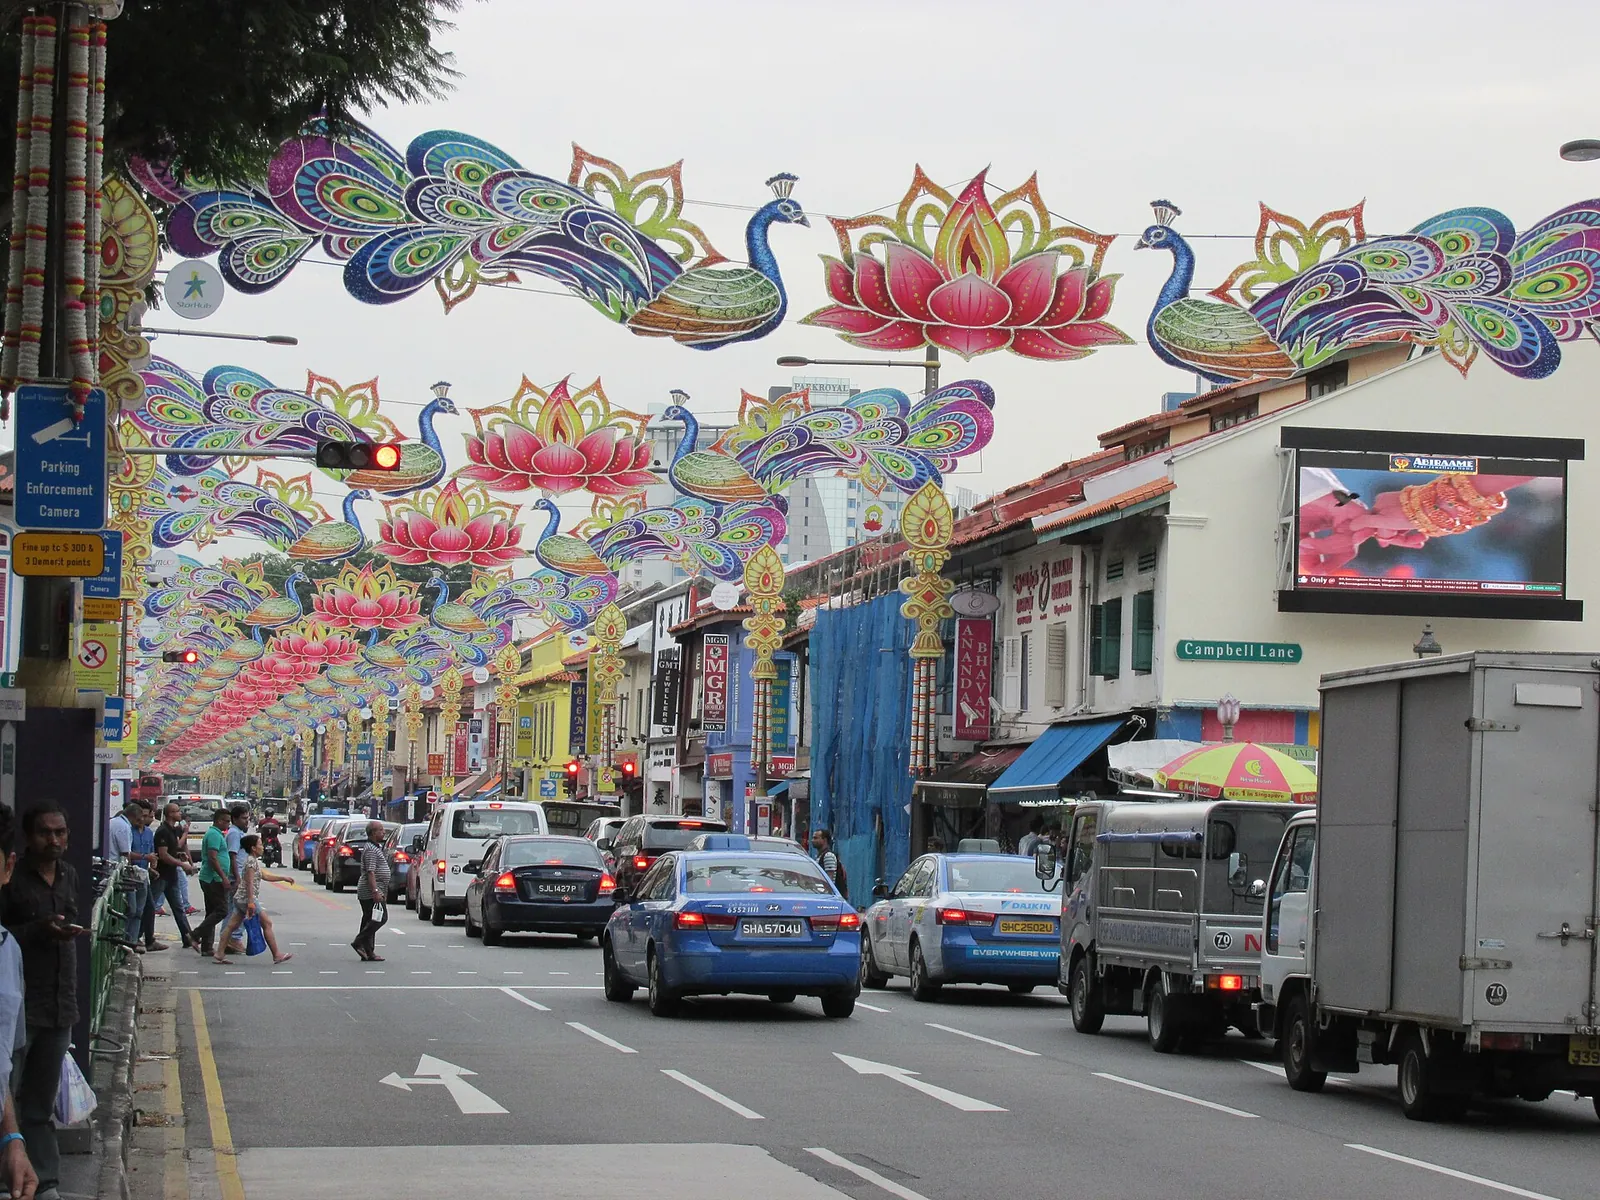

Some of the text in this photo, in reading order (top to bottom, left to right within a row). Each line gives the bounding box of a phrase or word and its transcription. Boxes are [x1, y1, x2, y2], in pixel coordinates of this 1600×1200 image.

[41, 460, 80, 476] Parking
[1413, 457, 1474, 468] ABIRAAME
[27, 482, 93, 496] Enforcement
[39, 505, 80, 518] Camera
[22, 543, 38, 551] Fine
[63, 543, 69, 552] $
[71, 544, 86, 552] 300
[25, 557, 91, 567] 3 Demerit points
[1310, 576, 1327, 584] Only
[706, 636, 727, 644] MGM
[1184, 642, 1294, 658] Campbell Lane
[658, 660, 679, 669] GMT
[960, 624, 974, 702] ANANDA
[706, 659, 726, 705] MGR
[975, 642, 988, 720] BHAVAN
[662, 669, 671, 723] JEWELLERS
[1255, 791, 1285, 799] Singapore
[1012, 902, 1051, 910] DAIKIN
[1001, 922, 1053, 933] SHC2502U
[1217, 935, 1230, 944] 70
[972, 949, 1039, 957] EVERYWHERE
[1490, 986, 1503, 997] 70
